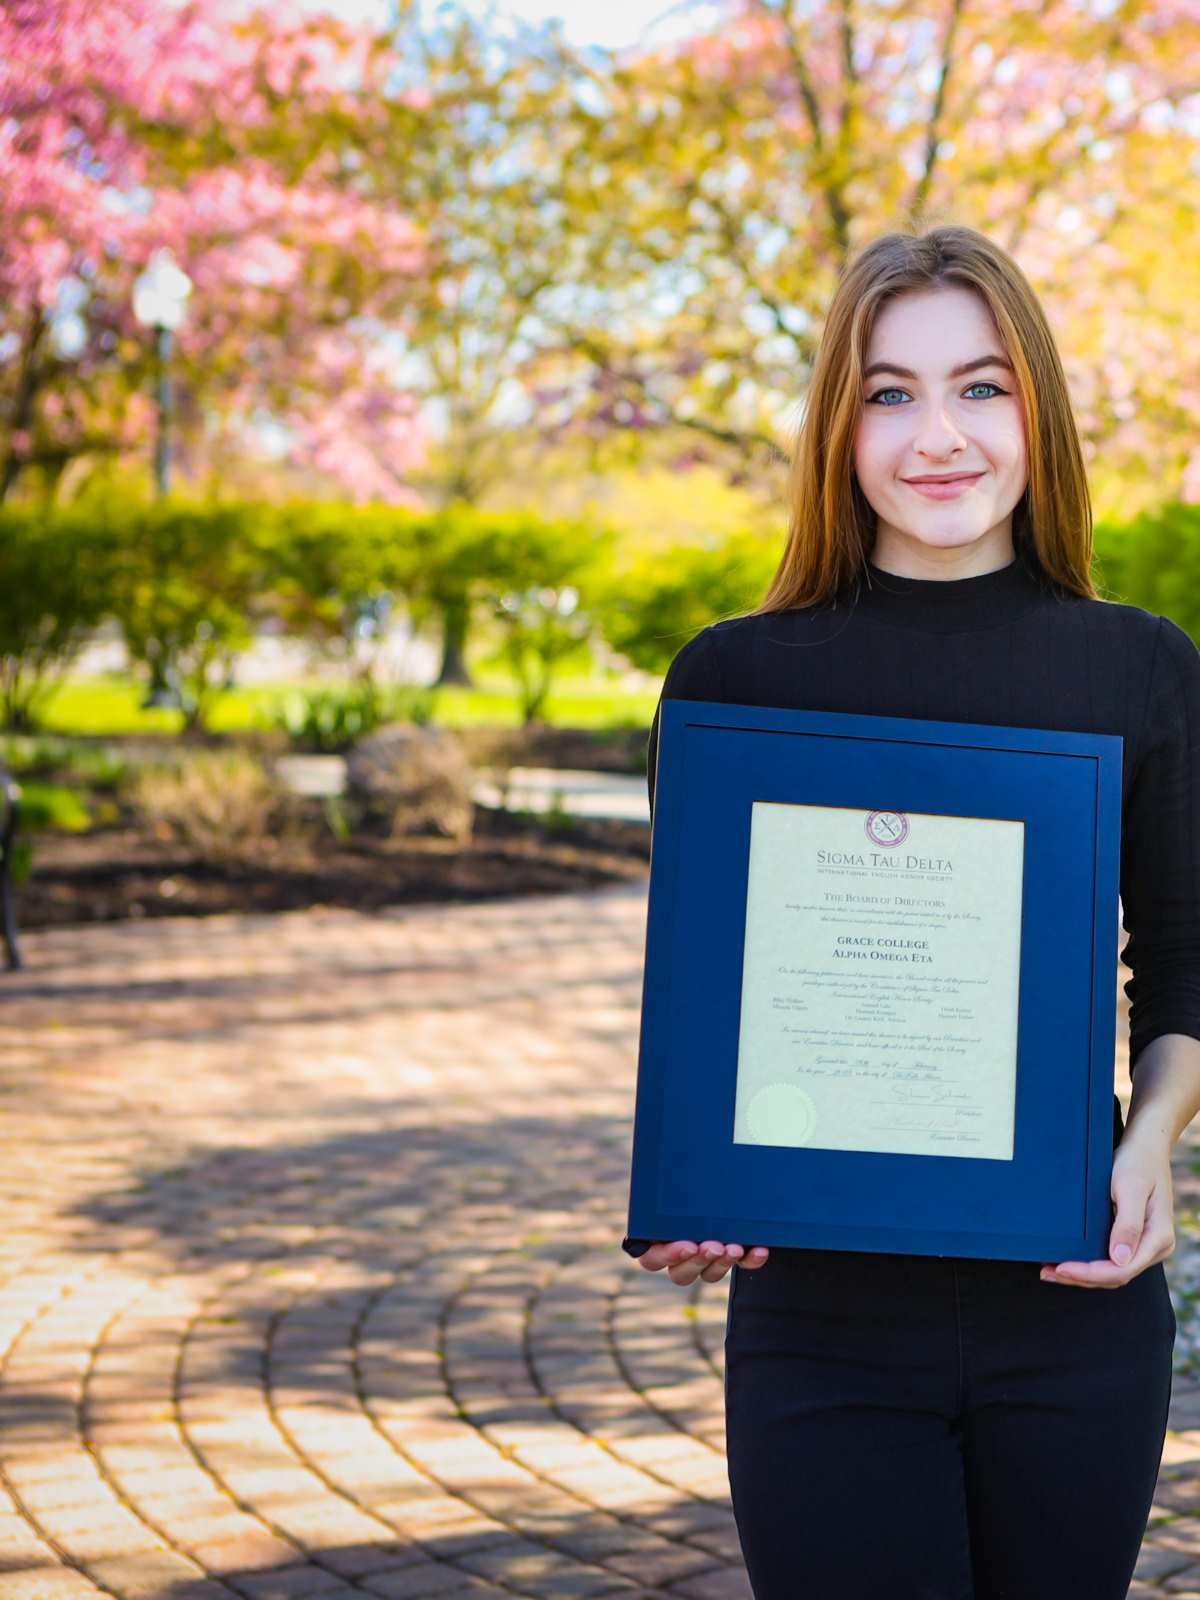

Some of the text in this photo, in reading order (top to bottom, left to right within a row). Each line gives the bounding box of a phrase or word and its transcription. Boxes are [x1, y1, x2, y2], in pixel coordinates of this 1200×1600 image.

[816, 849, 953, 872] SIGMA TAU DELTA
[824, 892, 844, 903] THE
[846, 893, 879, 905] BOARD
[894, 896, 946, 908] DIRECTORS
[837, 935, 929, 950] GRACE COLLEGE
[832, 949, 933, 964] ALPHA OMEGA ETA
